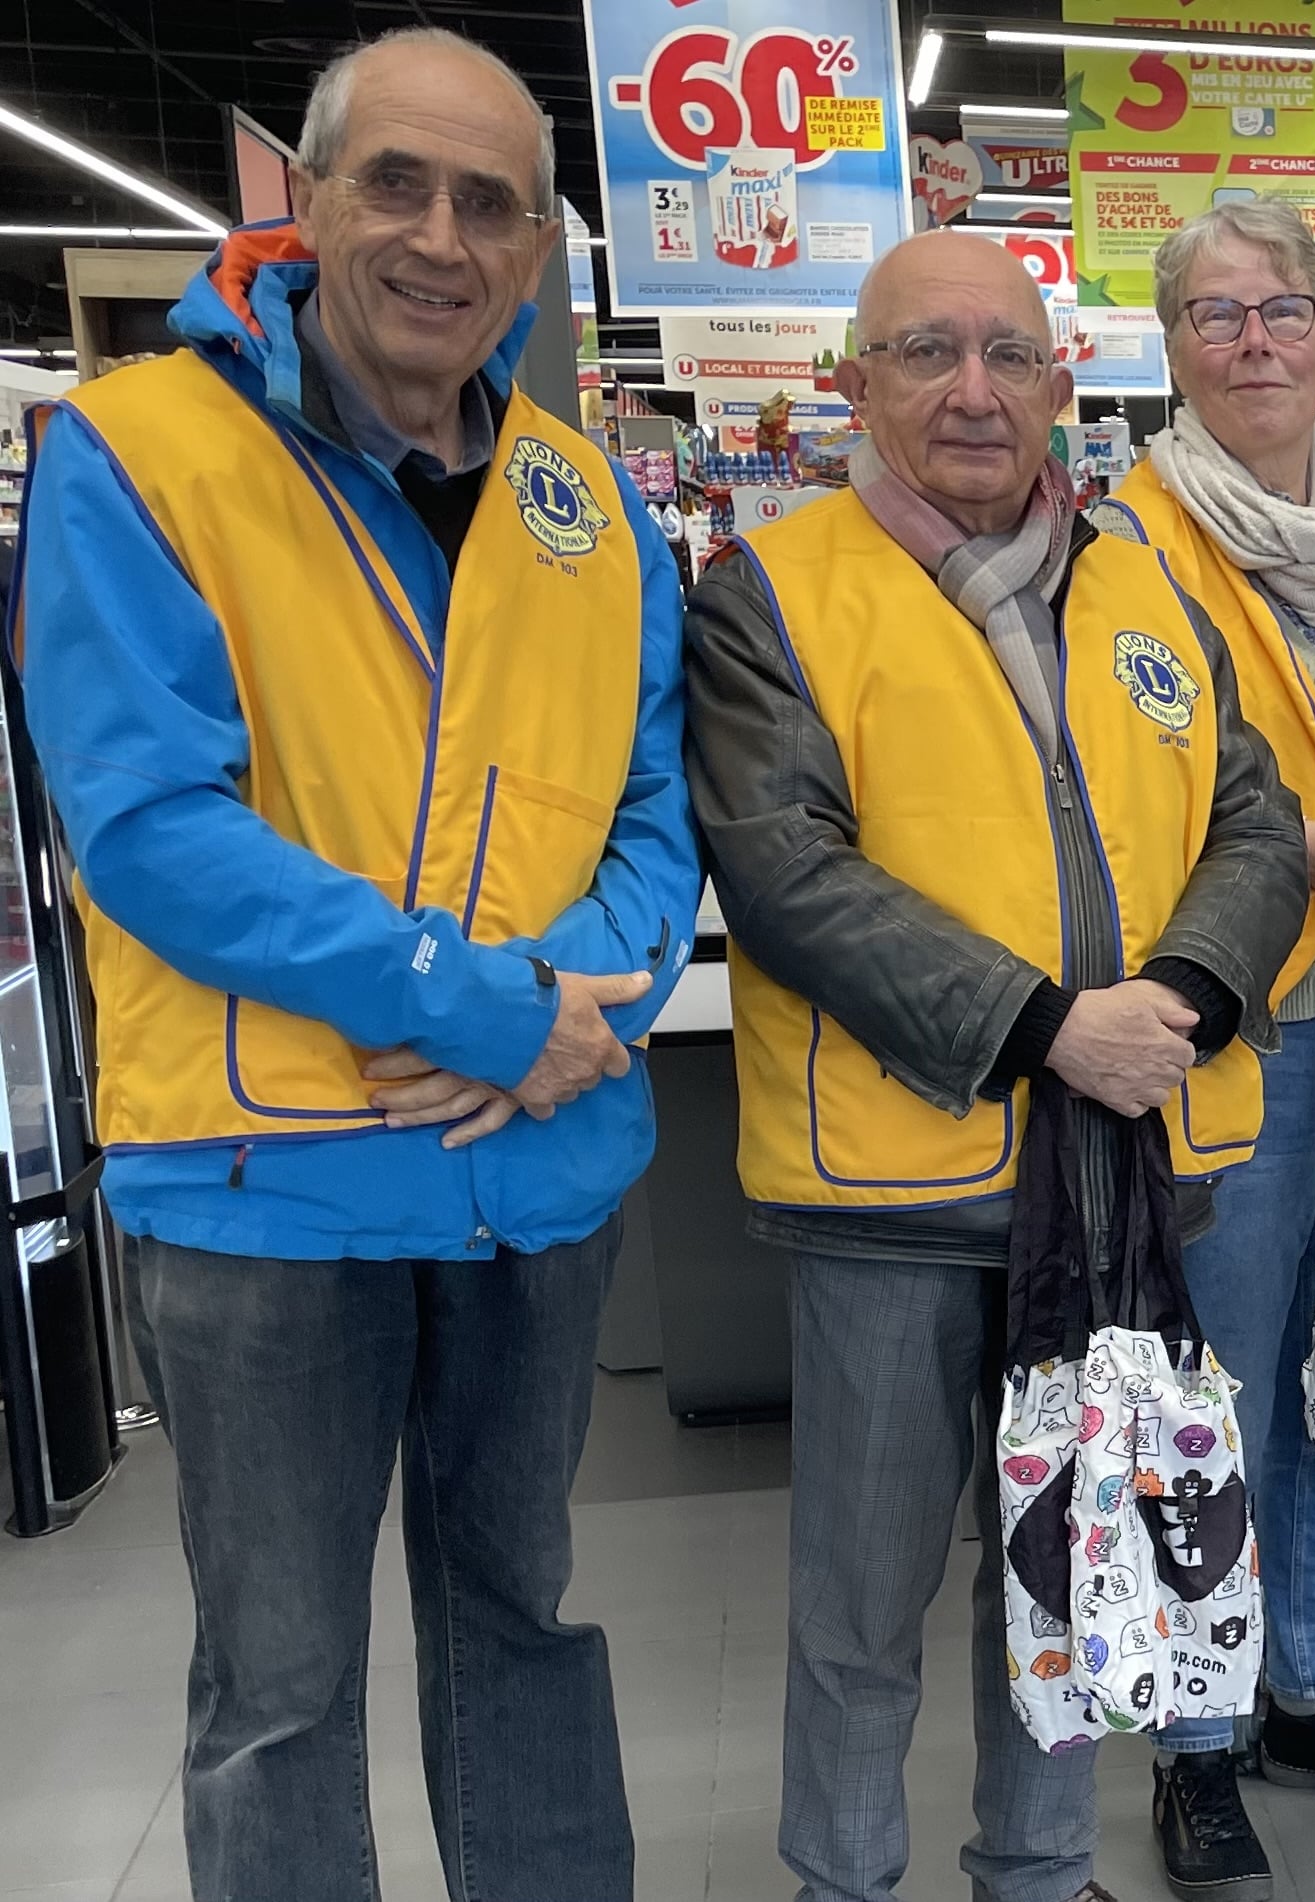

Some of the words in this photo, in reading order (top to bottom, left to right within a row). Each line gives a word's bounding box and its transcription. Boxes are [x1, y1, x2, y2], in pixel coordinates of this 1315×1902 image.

[1191, 74, 1217, 87] MIS
[1221, 74, 1241, 87] EN
[1244, 75, 1272, 89] JEU
[1275, 76, 1313, 89] AVEC
[809, 99, 827, 109] DE
[830, 100, 877, 110] REMISE
[1191, 91, 1239, 103] VOTRE
[1244, 92, 1292, 105] CARTE
[810, 124, 835, 134] SUR
[840, 125, 853, 135] LE
[829, 137, 863, 147] PACK
[918, 146, 968, 184] kinder
[1126, 157, 1180, 168] CHANCE
[730, 164, 768, 178] kinder
[731, 170, 782, 196] maxi
[1096, 191, 1120, 203] DES
[1123, 192, 1159, 203] BONS
[1097, 204, 1153, 215] D'ACHAT
[1155, 205, 1172, 215] DE
[1121, 217, 1137, 229] 5€
[1140, 217, 1157, 229] ET
[638, 287, 664, 295] POUR
[665, 287, 692, 295] VOTRE
[755, 287, 766, 296] DE
[820, 288, 846, 296] ENTRE
[1107, 314, 1155, 322] RETROUVEZ
[709, 320, 744, 332] tous
[749, 319, 771, 333] les
[774, 320, 817, 336] jours
[678, 361, 693, 375] U
[704, 363, 745, 374] LOCAL
[748, 364, 761, 374] ET
[520, 441, 576, 482] LIONS
[540, 471, 571, 520] L
[762, 504, 777, 517] U
[527, 511, 590, 548] INTERNATIONAL
[1118, 633, 1167, 659] LIONS
[1140, 659, 1172, 696] L
